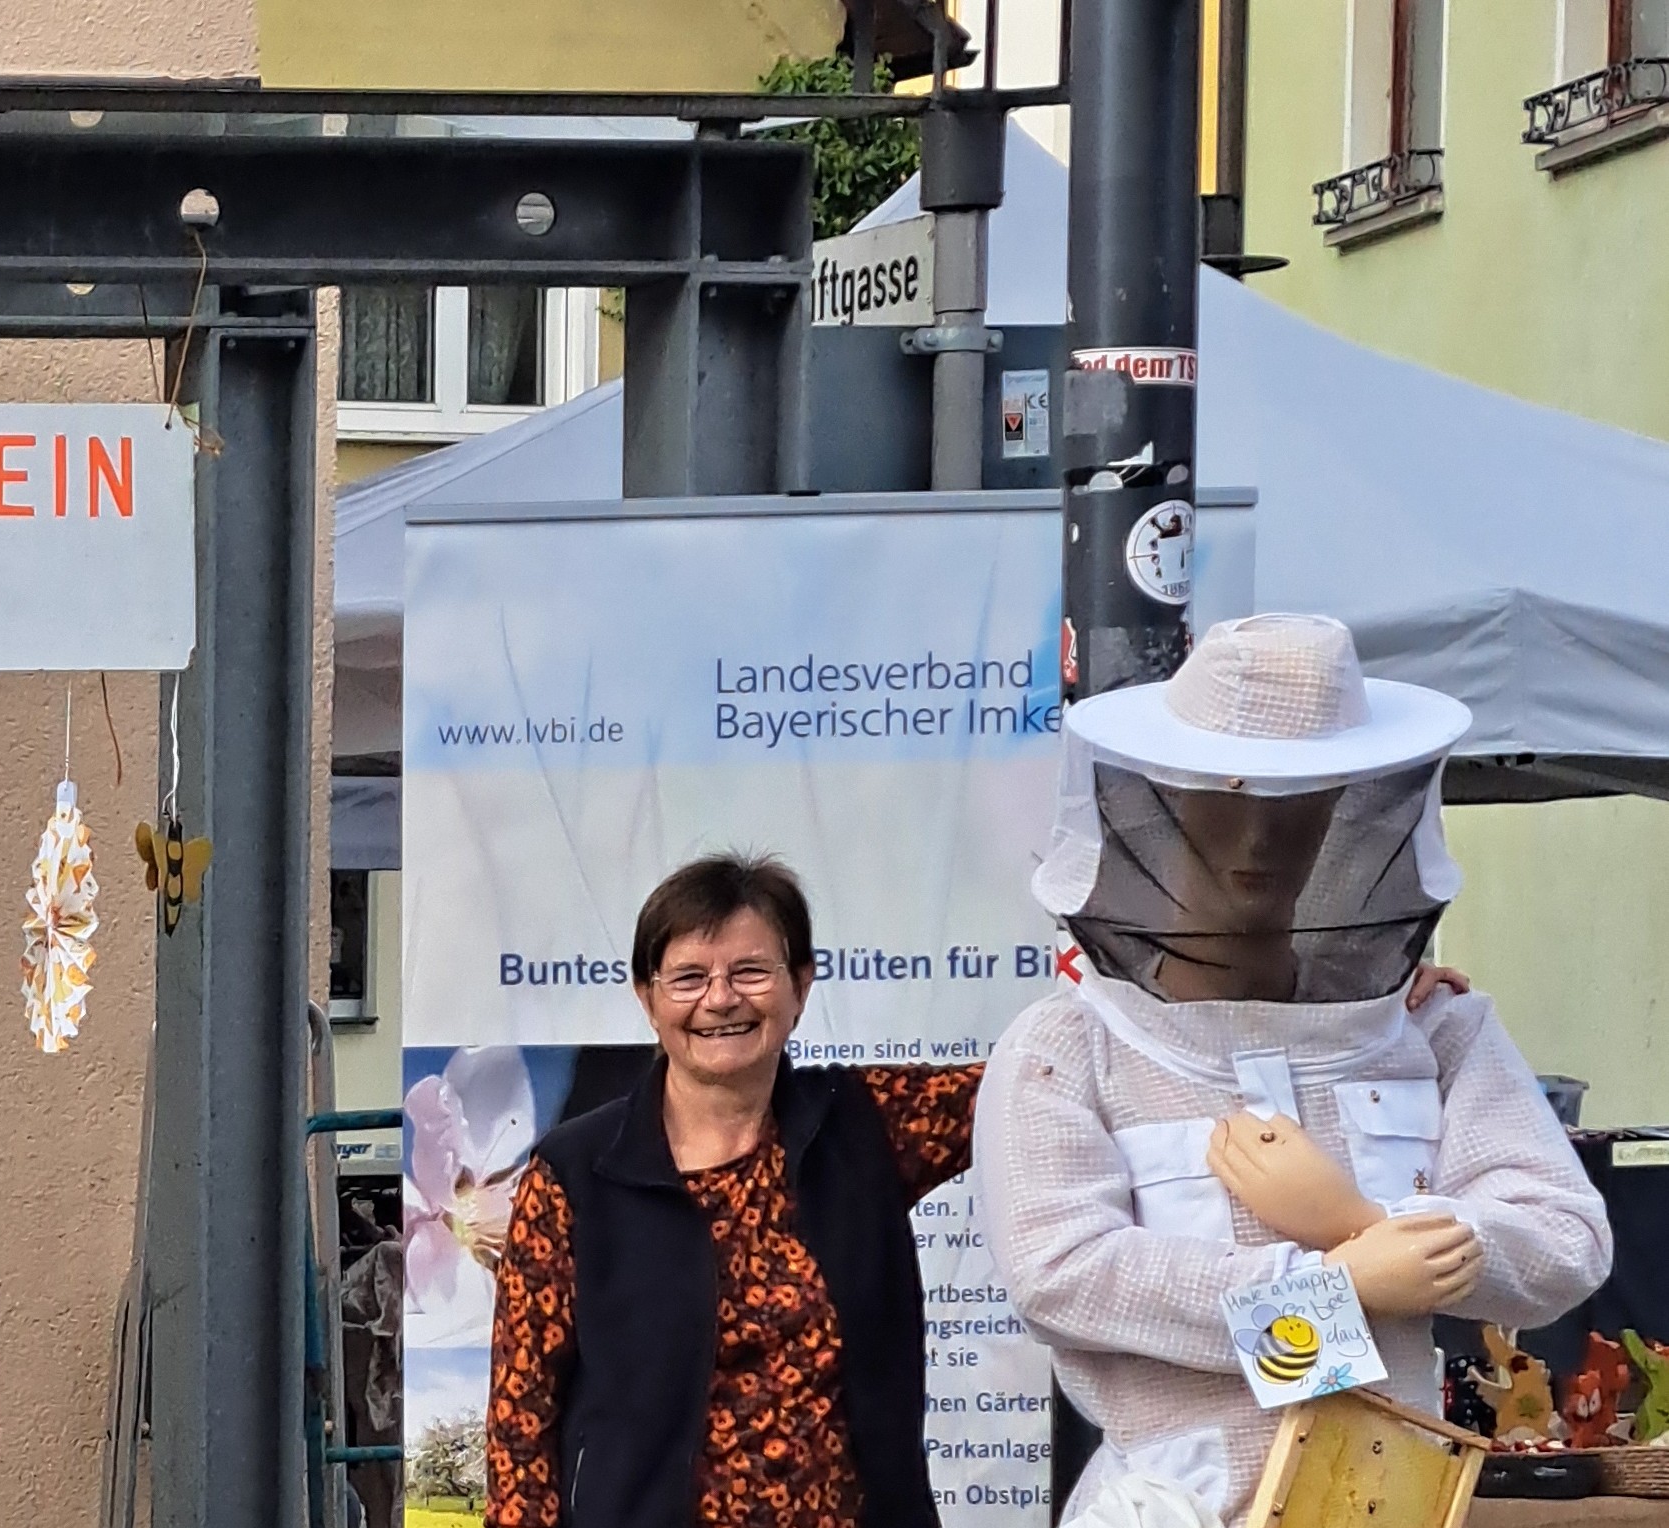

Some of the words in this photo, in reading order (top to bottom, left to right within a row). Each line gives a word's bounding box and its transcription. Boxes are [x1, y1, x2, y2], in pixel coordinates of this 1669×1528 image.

[716, 649, 1034, 694] Landesverband
[437, 716, 624, 746] www.lvbi.de
[716, 697, 954, 749] Bayerischer
[500, 952, 628, 986] Buntes
[813, 948, 931, 981] Blüten
[946, 945, 1000, 979] für
[788, 1039, 864, 1060] Bienen
[873, 1037, 922, 1059] sind
[930, 1037, 980, 1058] weit
[1285, 1266, 1348, 1294] happy
[946, 1347, 979, 1368] sie
